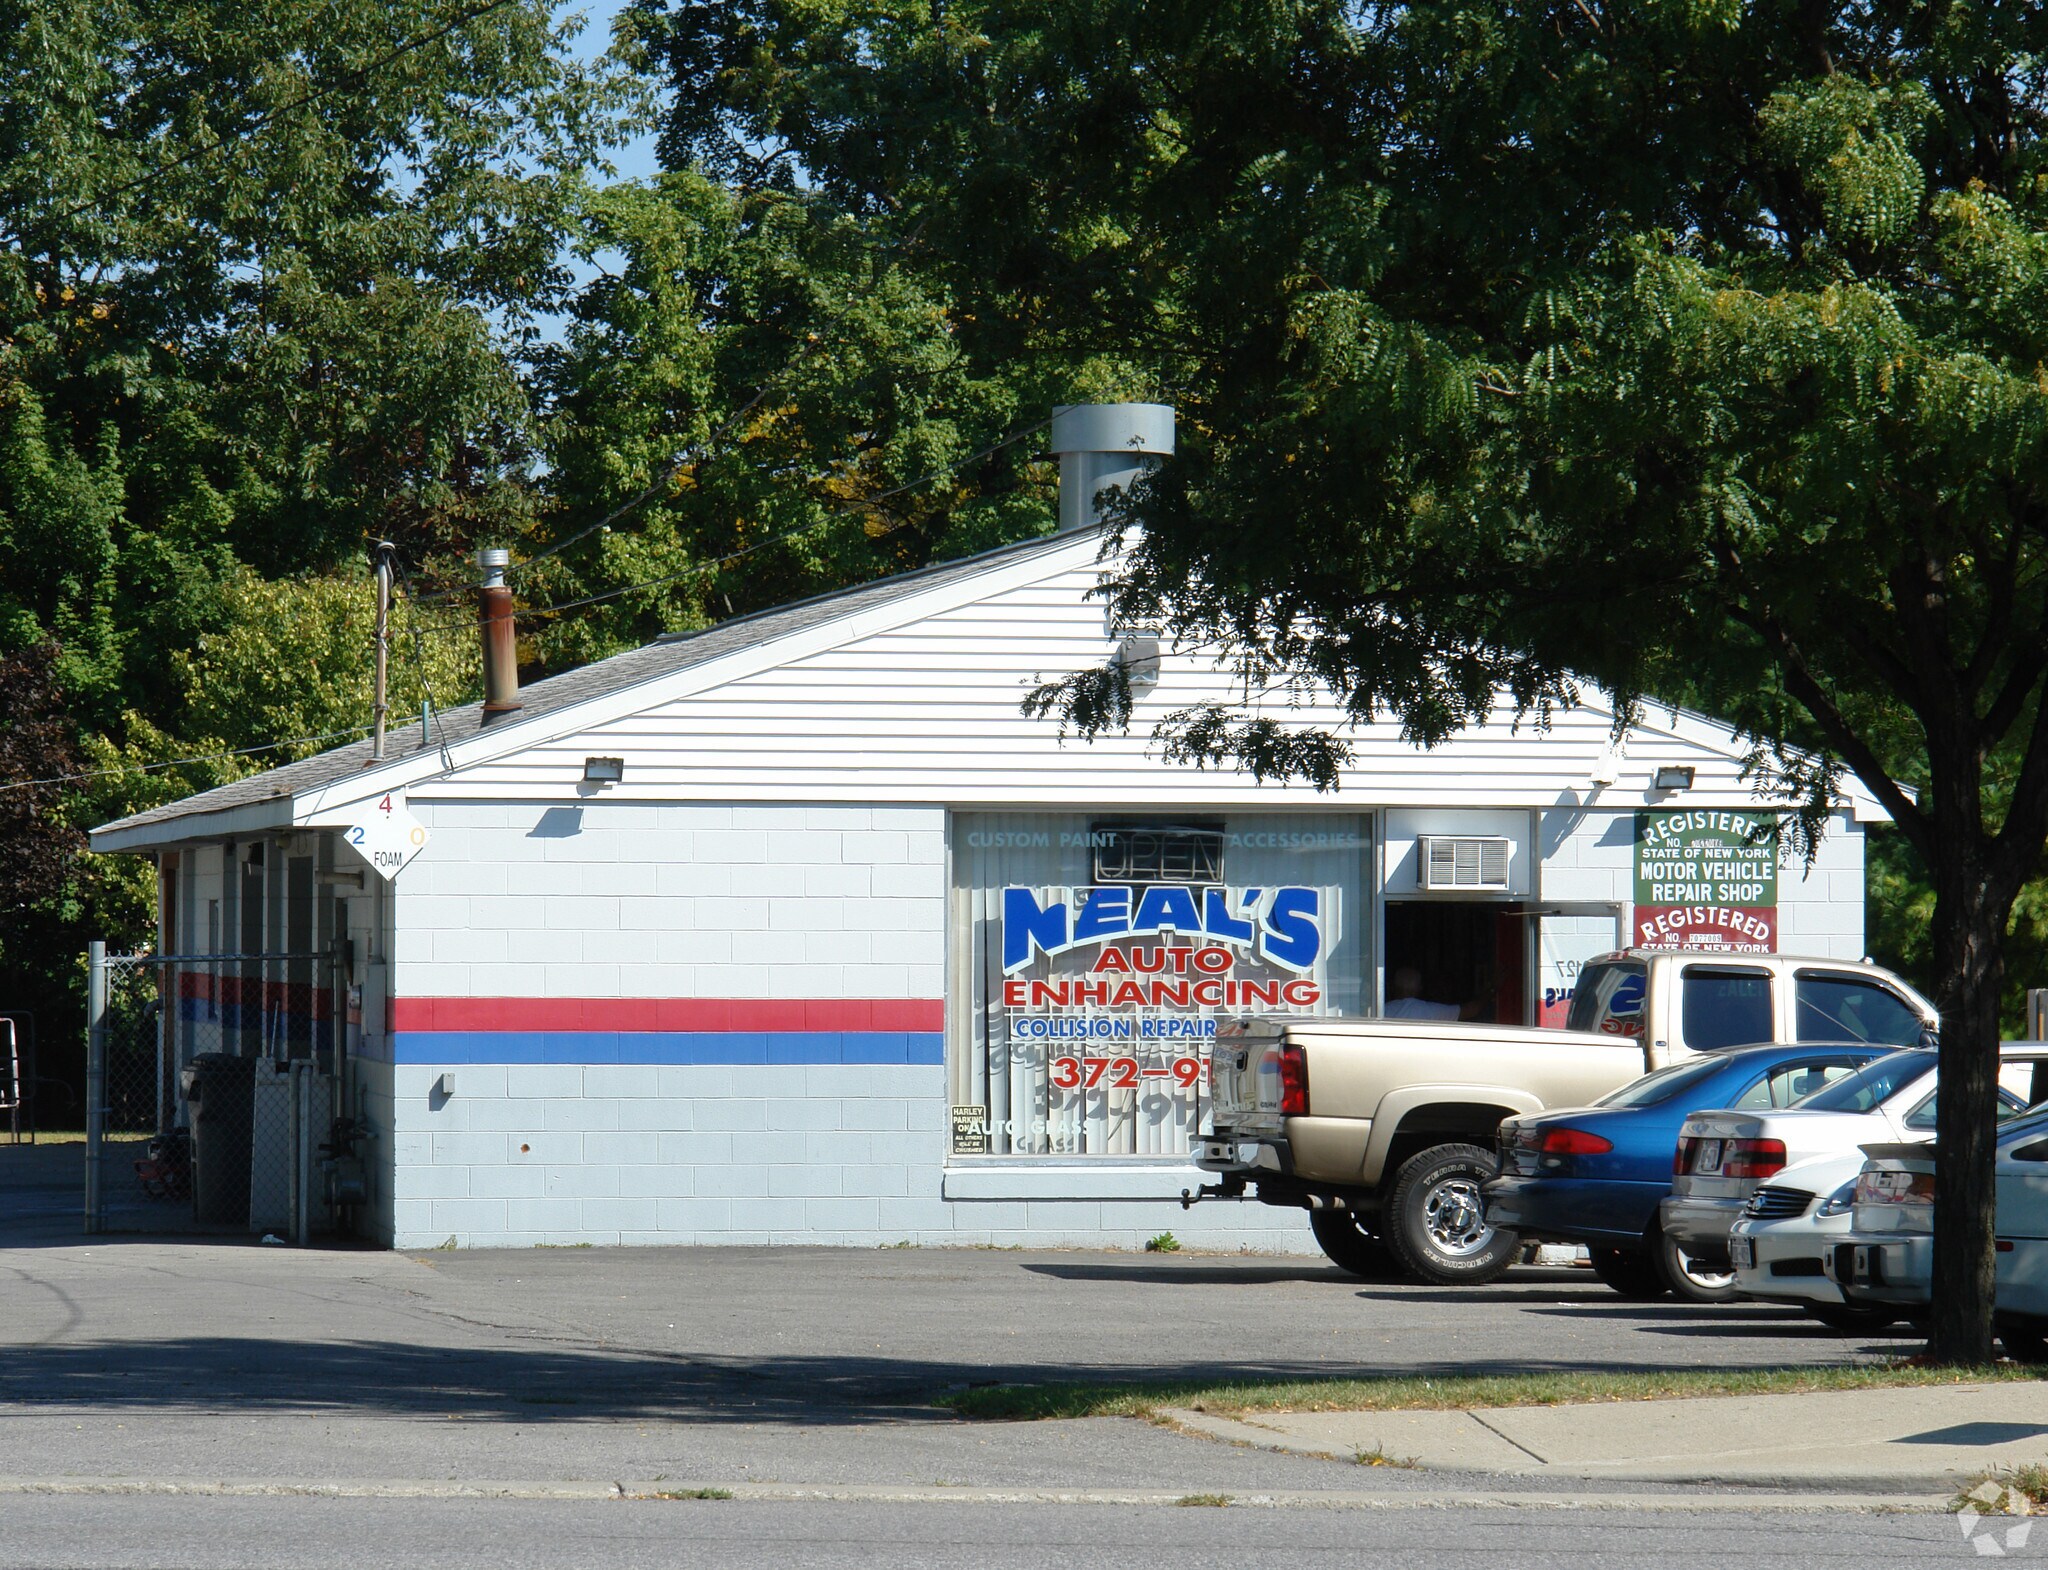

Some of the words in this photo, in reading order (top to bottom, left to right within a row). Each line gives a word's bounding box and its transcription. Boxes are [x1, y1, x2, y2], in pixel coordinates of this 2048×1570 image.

[379, 795, 393, 813] 4
[352, 826, 365, 845] 2
[410, 827, 425, 846] 0
[967, 832, 1049, 848] CUSTOM
[1060, 832, 1118, 848] PAINT
[1229, 832, 1356, 848] ACCESSORIES
[374, 851, 403, 867] FOAM
[1099, 833, 1222, 880] OPEN
[1642, 848, 1680, 858] STATE
[1684, 848, 1702, 858] OF
[1705, 848, 1733, 858] NEW
[1737, 848, 1771, 858] YORK
[1640, 861, 1698, 880] MOTOR
[1702, 861, 1773, 880] VEHICLE
[1652, 883, 1713, 902] REPAIR
[1718, 883, 1764, 902] SHOP
[1002, 886, 1321, 976] NEAL'S
[1640, 906, 1770, 941] REGISTERED
[1703, 943, 1732, 951] NEW
[1735, 944, 1770, 953] YORK
[1092, 946, 1235, 974] AUTO
[1002, 979, 1321, 1008] ENHANCING
[1016, 1018, 1131, 1038] COLLISION
[1141, 1018, 1217, 1038] REPAIR
[953, 1107, 983, 1116] HARLEY
[953, 1116, 984, 1124] PARKING
[966, 1119, 1015, 1135] AUTO
[1030, 1119, 1092, 1135] GLASS
